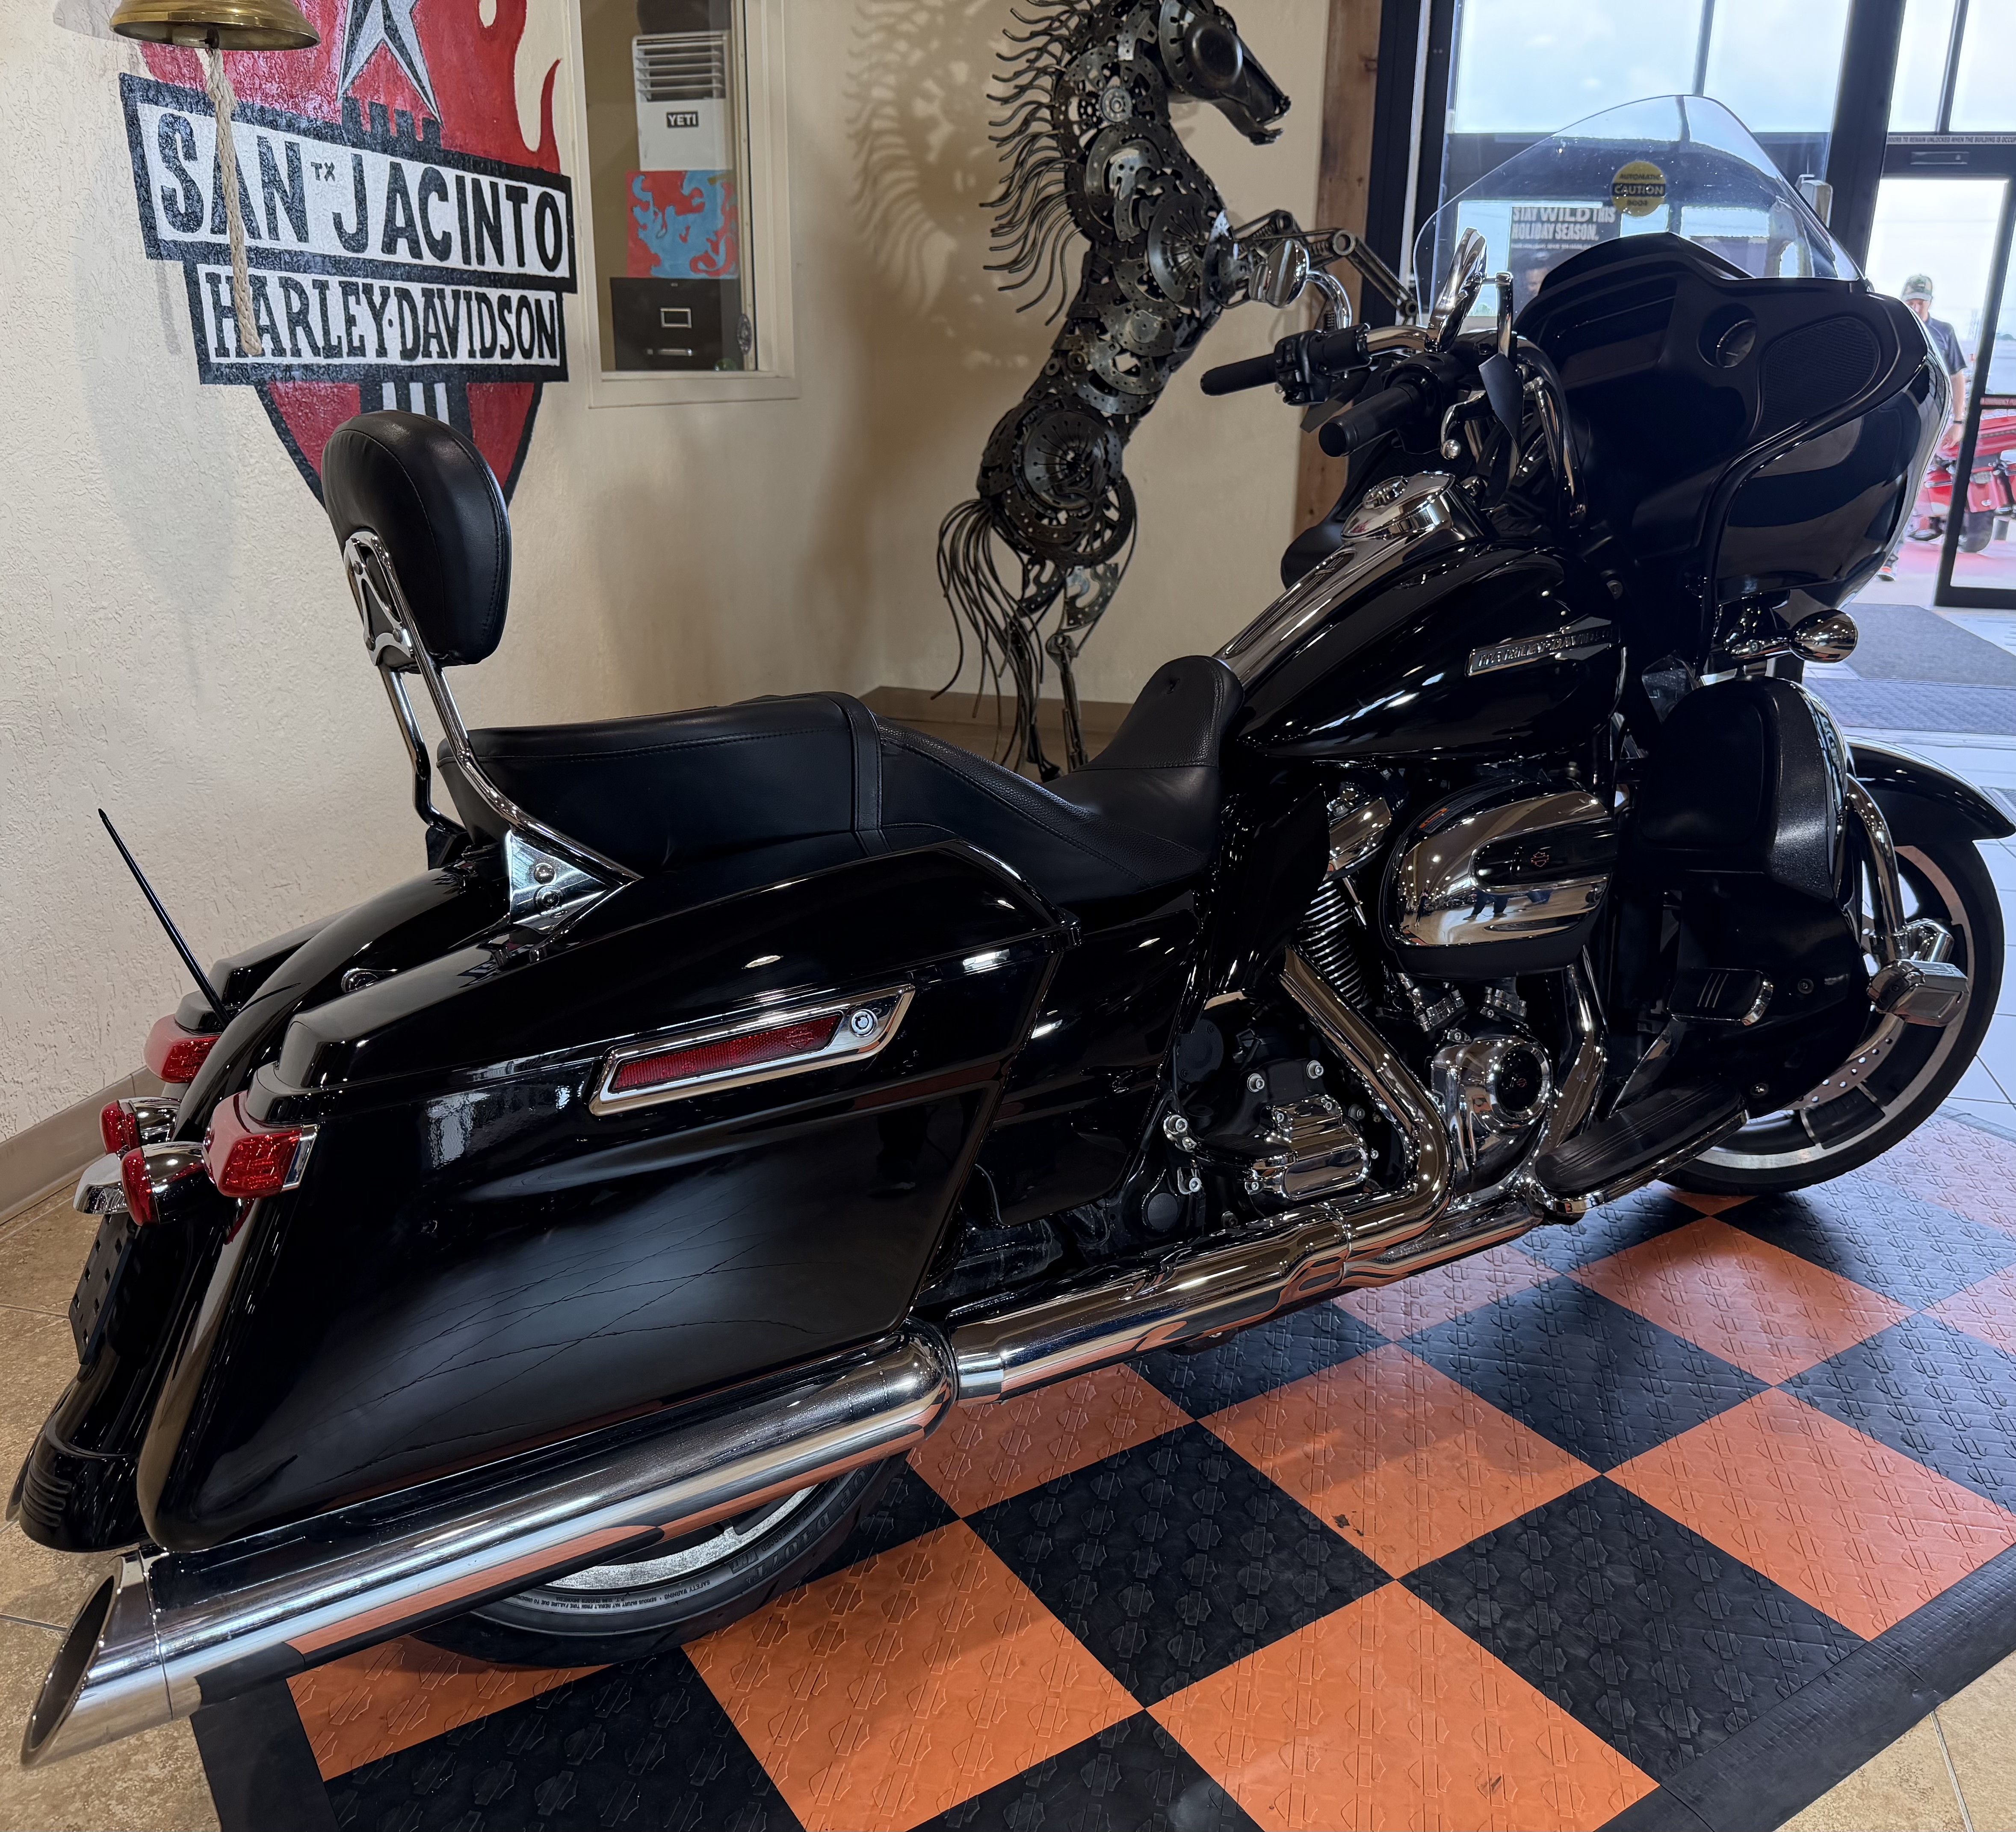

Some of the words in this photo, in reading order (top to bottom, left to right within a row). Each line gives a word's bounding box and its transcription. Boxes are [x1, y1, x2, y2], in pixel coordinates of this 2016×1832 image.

[668, 113, 697, 126] YETI
[159, 112, 309, 243] SAN
[331, 153, 563, 272] JACINTO
[1614, 184, 1664, 195] CAUTION
[1513, 207, 1538, 221] STAY
[1540, 207, 1591, 222] WILD
[1592, 206, 1616, 223] THIS
[1511, 223, 1555, 240] HOLIDAY
[761, 1520, 800, 1552] REINFORCED
[689, 1580, 710, 1592] SAFETY
[664, 1588, 687, 1600] WARNING
